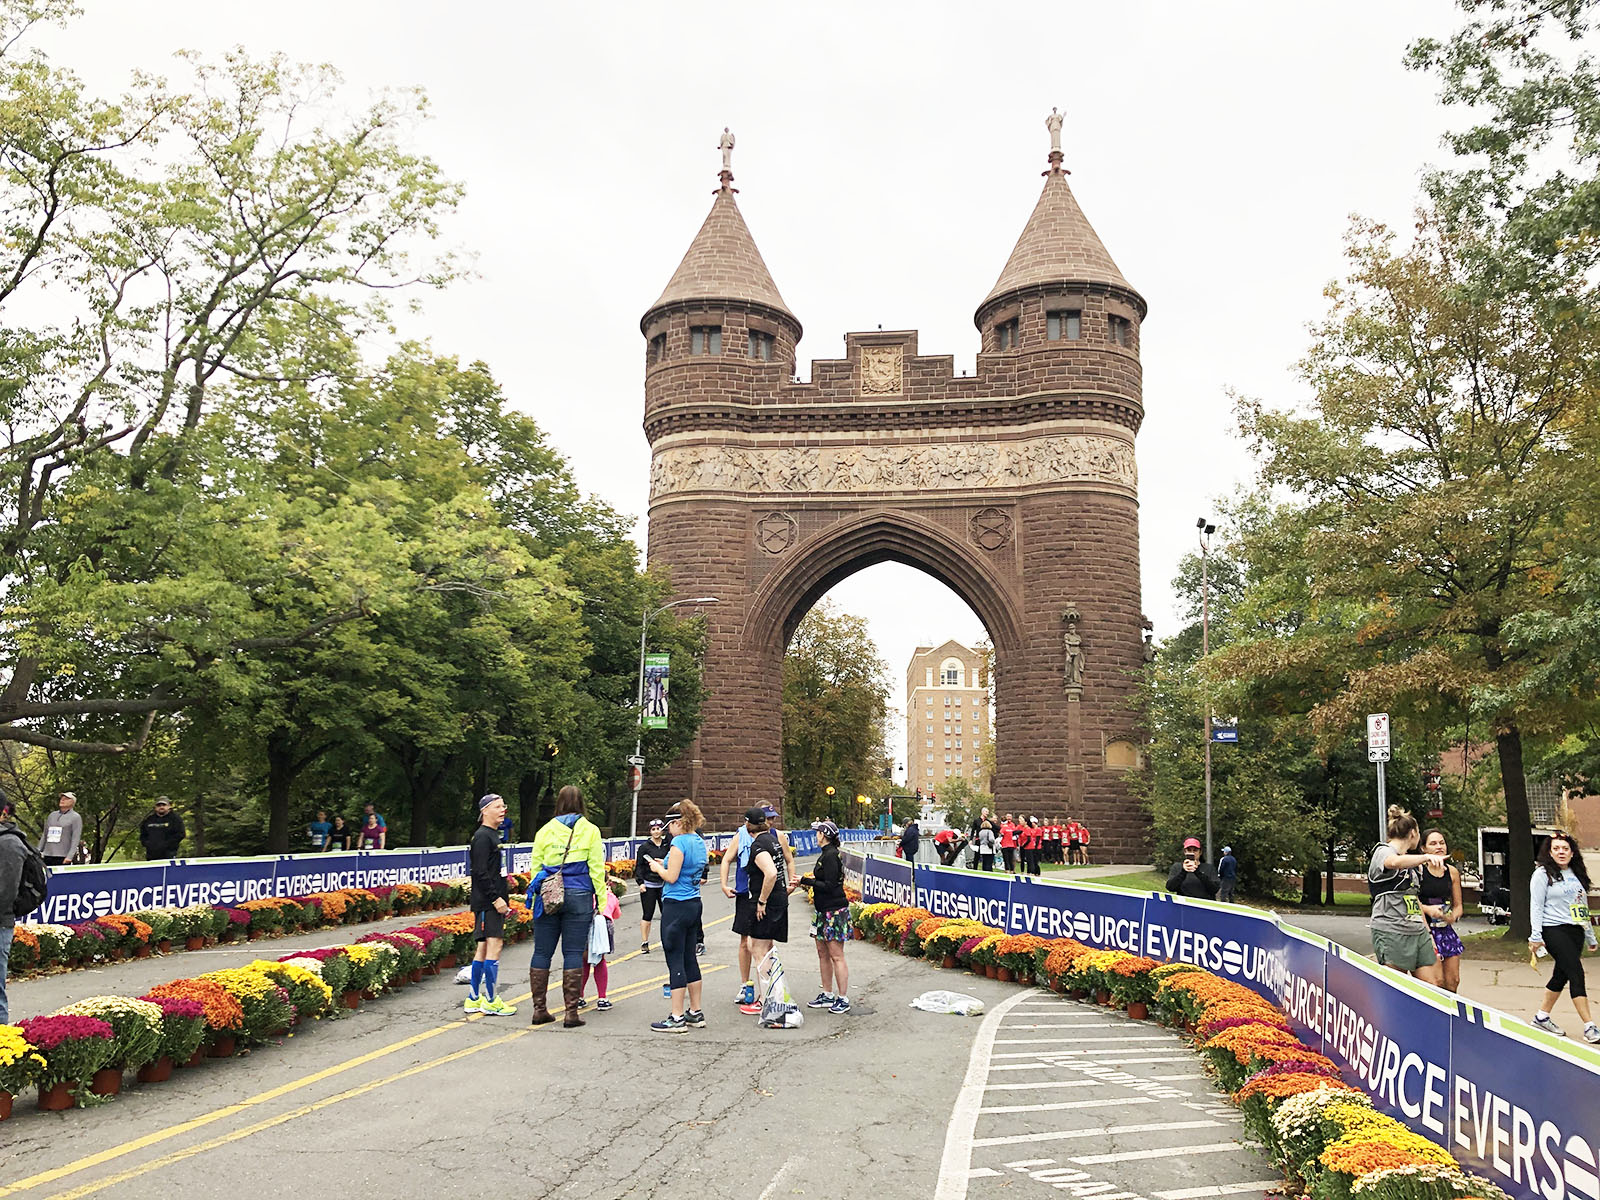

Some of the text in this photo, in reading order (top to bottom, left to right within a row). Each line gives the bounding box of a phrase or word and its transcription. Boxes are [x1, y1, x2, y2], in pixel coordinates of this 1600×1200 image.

[276, 871, 355, 898] EVERSOURCE
[356, 867, 419, 888] EVERSOURCE
[420, 862, 466, 883] EVERSOURCE
[166, 878, 273, 908] EVERSOURCE
[864, 874, 911, 907] EVERSOURCE
[916, 887, 1006, 927] EVERSOURCE
[1011, 902, 1140, 952] EVERSOURCE
[1324, 992, 1447, 1136] EVERSOURCE
[1455, 1074, 1600, 1200] EVERSO
